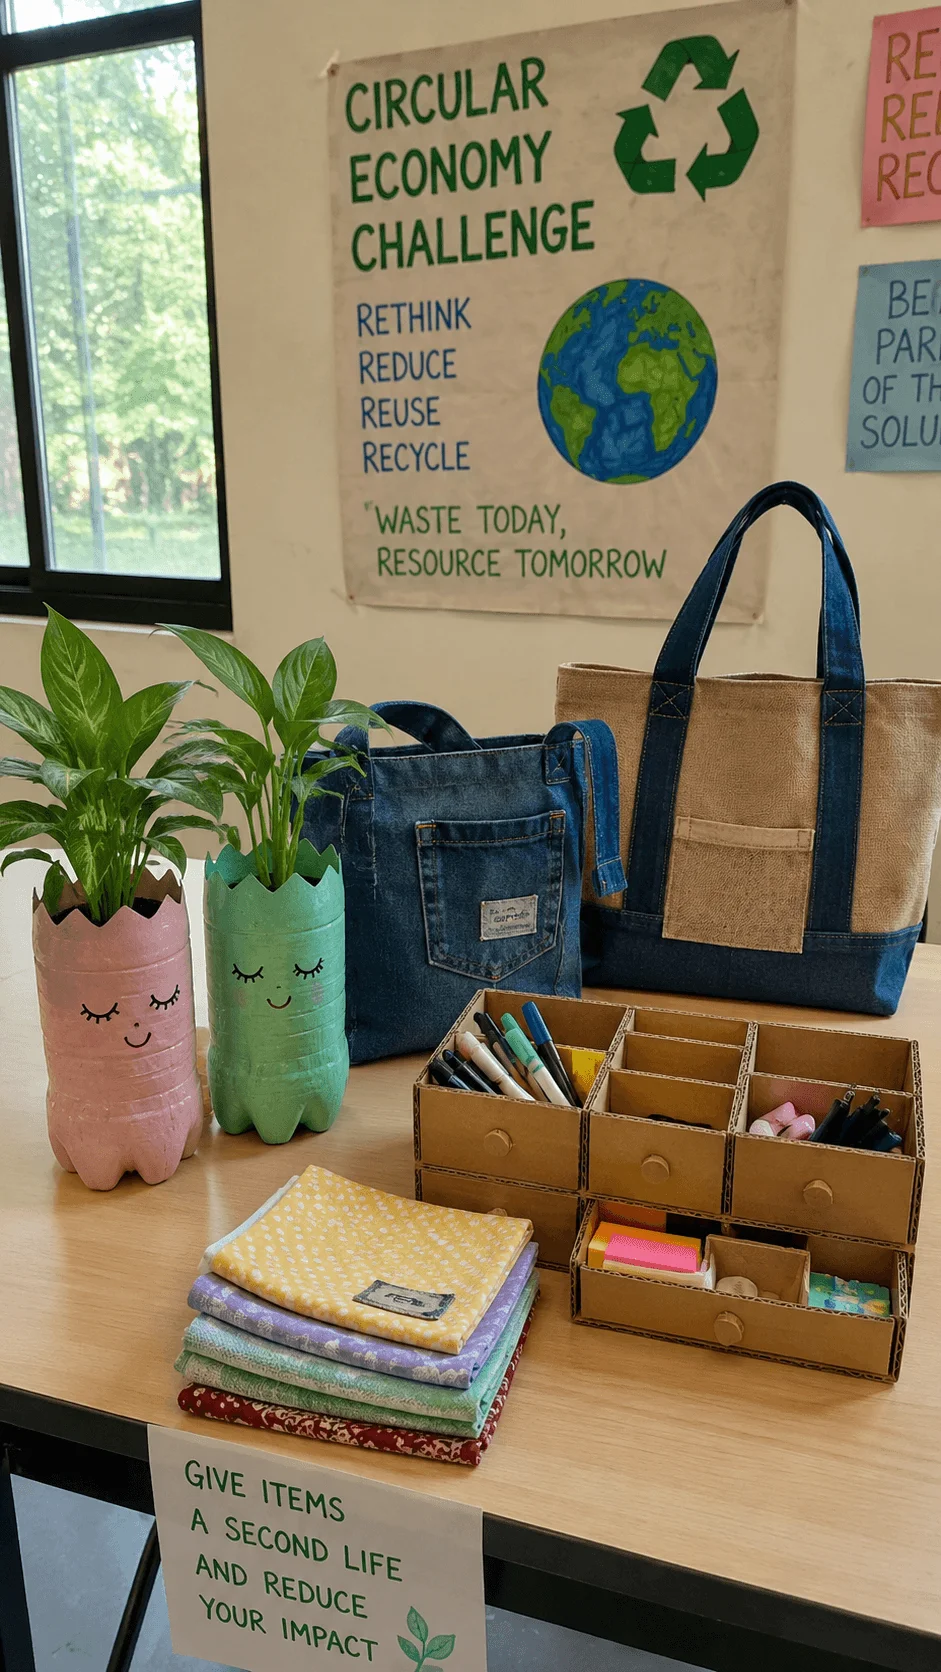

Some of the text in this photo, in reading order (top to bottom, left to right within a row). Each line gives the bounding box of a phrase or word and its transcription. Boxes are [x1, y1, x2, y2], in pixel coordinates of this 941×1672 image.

[885, 27, 941, 84] RE
[345, 57, 549, 134] CIRCULAR
[350, 130, 552, 203] ECONOMY
[351, 199, 595, 272] CHALLENGE
[356, 297, 472, 338] RETHINK
[876, 325, 941, 365] PAR
[359, 348, 457, 385] REDUCE
[862, 374, 898, 405] OF
[360, 396, 441, 430] REUSE
[860, 413, 941, 449] SOLU
[362, 440, 471, 474] RECYCLE
[476, 503, 566, 540] TODAY,
[377, 546, 667, 579] RESOURCE TOMORROW
[184, 1459, 345, 1522] GIVE ITEMS
[190, 1508, 403, 1582] A SECOND LIFE
[195, 1553, 368, 1619] AND REDUCE
[198, 1594, 379, 1662] YOUR IMPACT
